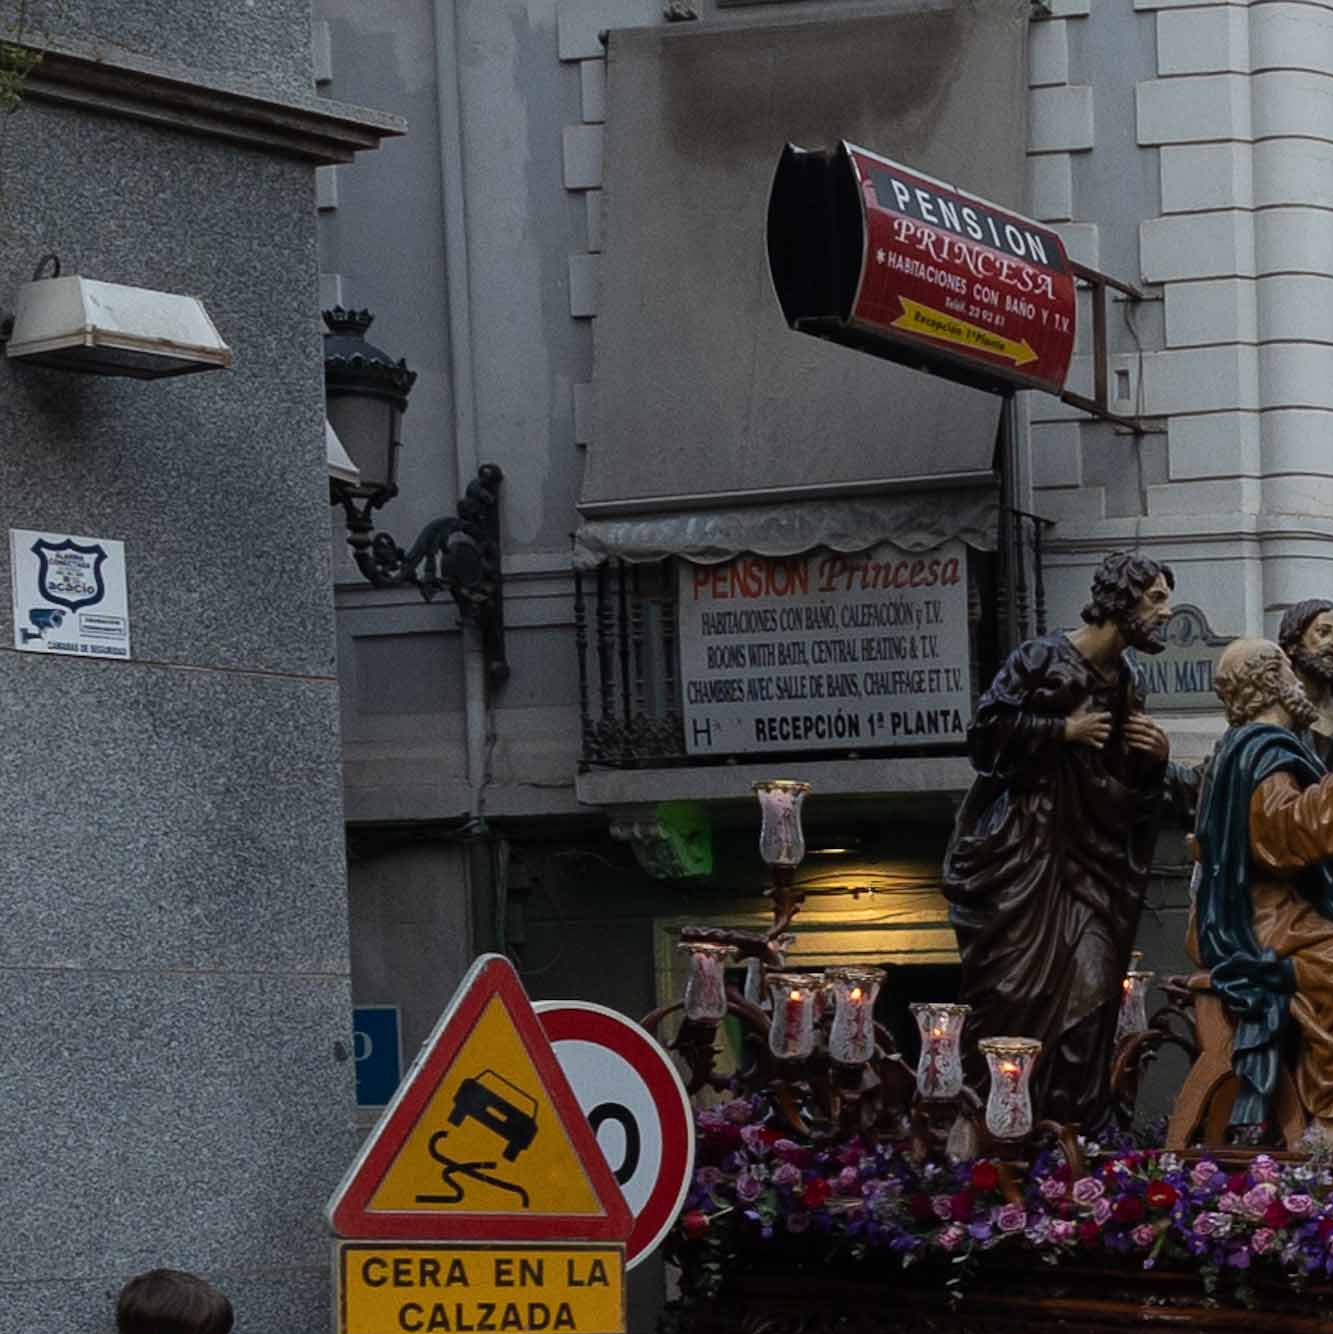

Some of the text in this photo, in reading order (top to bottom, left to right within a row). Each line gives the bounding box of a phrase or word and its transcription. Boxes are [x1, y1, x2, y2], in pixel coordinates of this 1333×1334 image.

[890, 178, 1049, 265] PENSION
[893, 218, 1056, 300] PRINCESA
[973, 282, 1000, 308] CON
[1005, 293, 1036, 320] BAÑO
[1041, 309, 1049, 326] Y
[693, 552, 961, 601] PENSION Princesa
[702, 608, 778, 636] HABITACIONES
[780, 606, 805, 631] CON
[841, 595, 913, 629] CALEFACCIÓN
[707, 646, 746, 669] ROOMS
[748, 643, 776, 667] WITH
[811, 639, 859, 664] CENTRAL
[861, 637, 907, 662] HEATING
[909, 637, 919, 659] &
[687, 679, 745, 705] CHAMBRES
[747, 678, 773, 702] AVEC
[776, 675, 807, 700] SALLE
[809, 675, 824, 698] DE
[864, 670, 927, 694] CHAUFFAGE
[928, 669, 943, 693] ET
[755, 708, 860, 743] RECEPCIÓN
[891, 709, 963, 736] PLANTA
[361, 1257, 609, 1287] CERA EN LA
[399, 1302, 577, 1332] CALZADA
